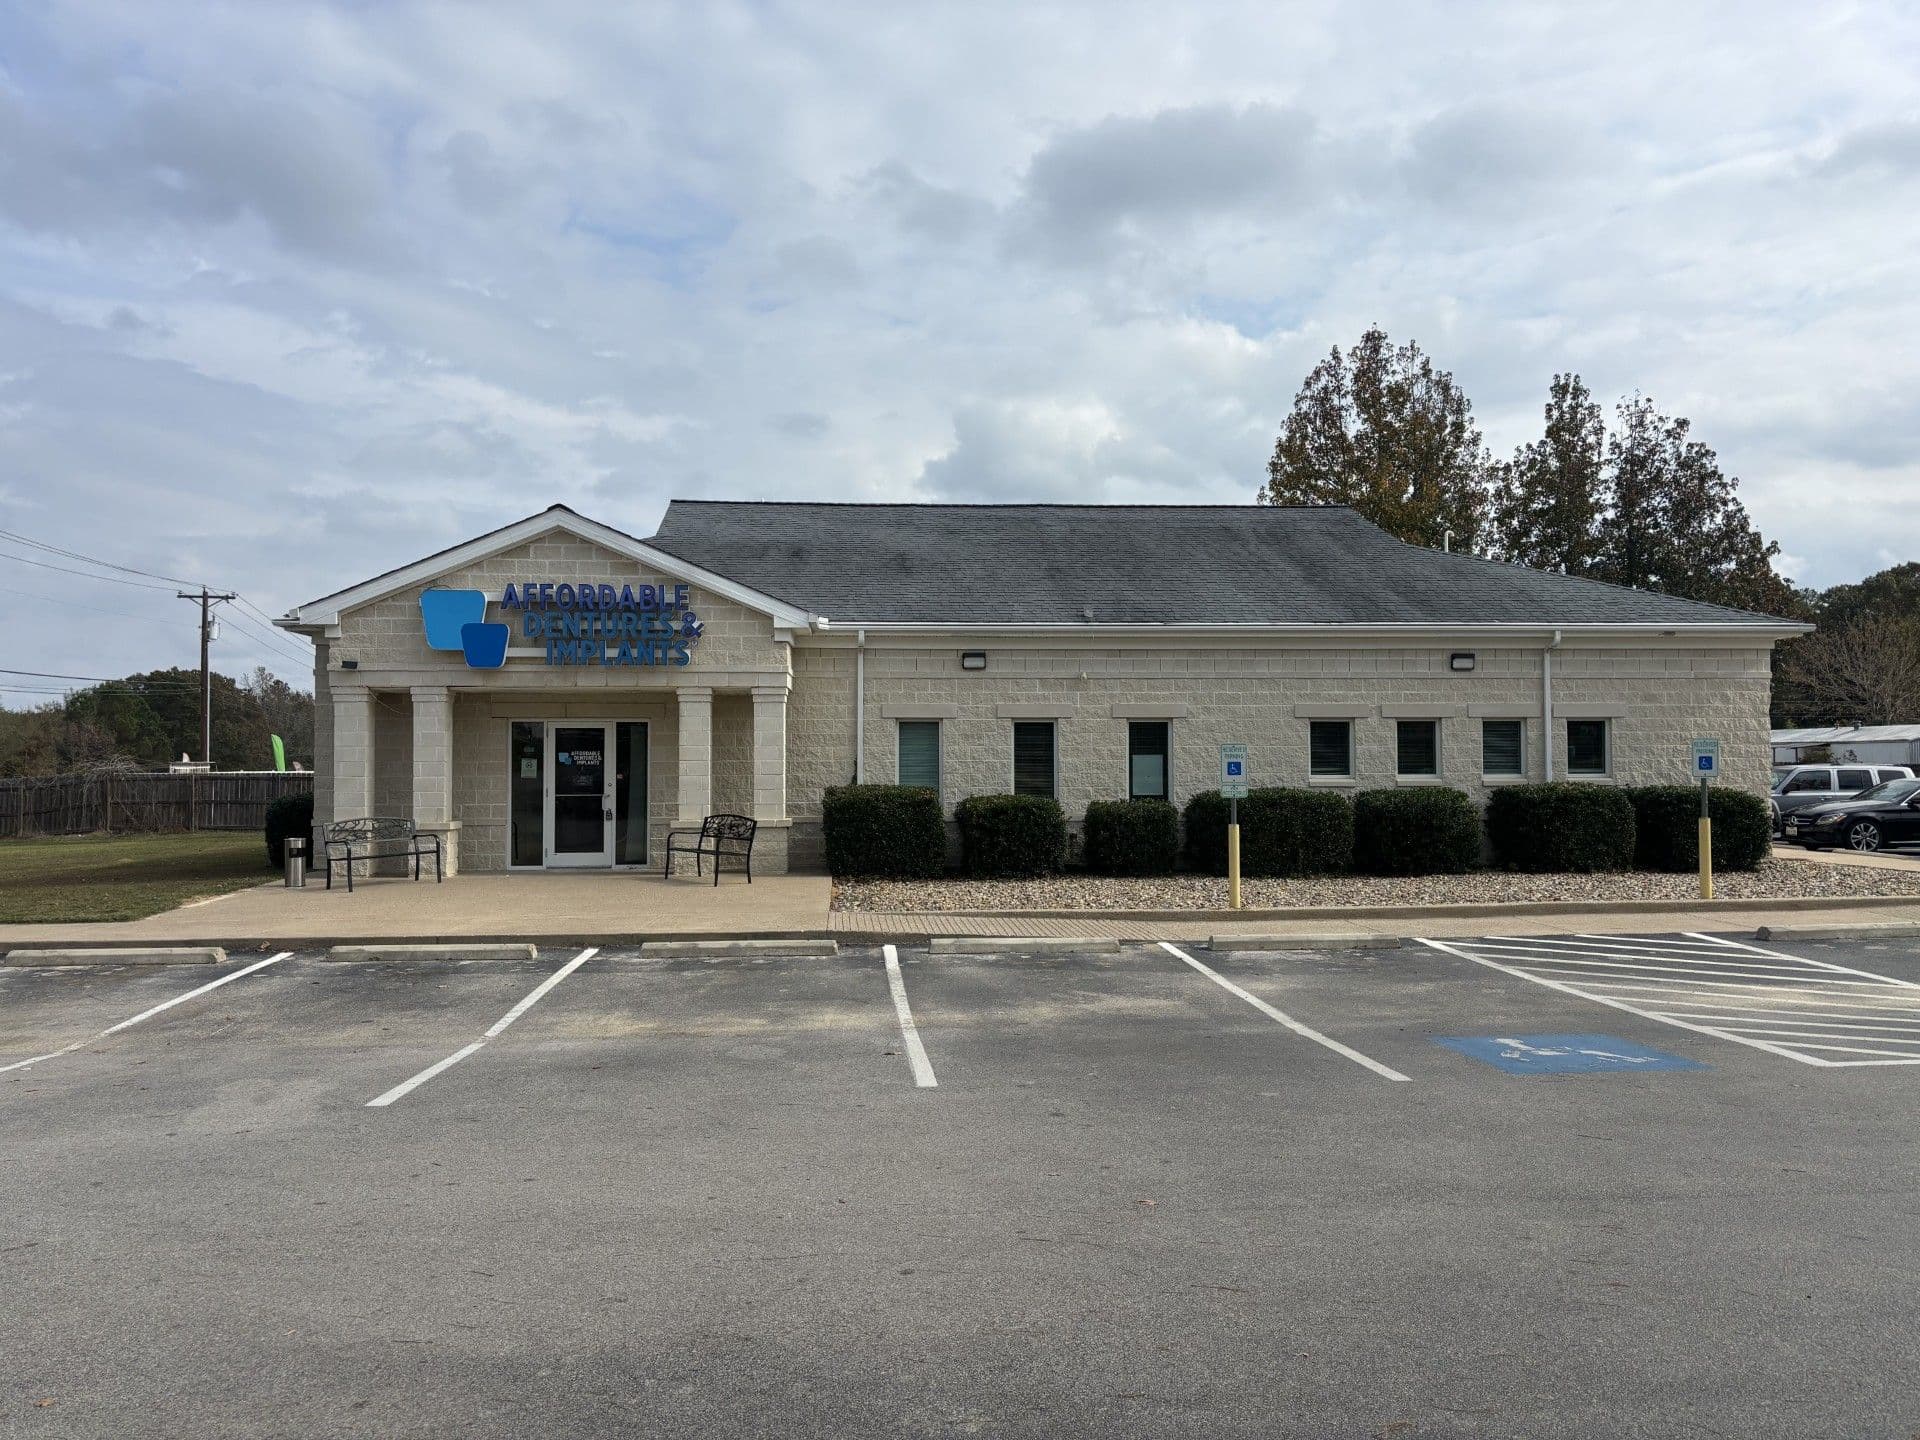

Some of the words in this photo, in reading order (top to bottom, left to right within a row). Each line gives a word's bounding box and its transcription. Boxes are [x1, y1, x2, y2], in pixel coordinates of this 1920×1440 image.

[500, 583, 690, 611] AFFORDABLE
[523, 611, 674, 638] DENTURES
[680, 611, 704, 638] &
